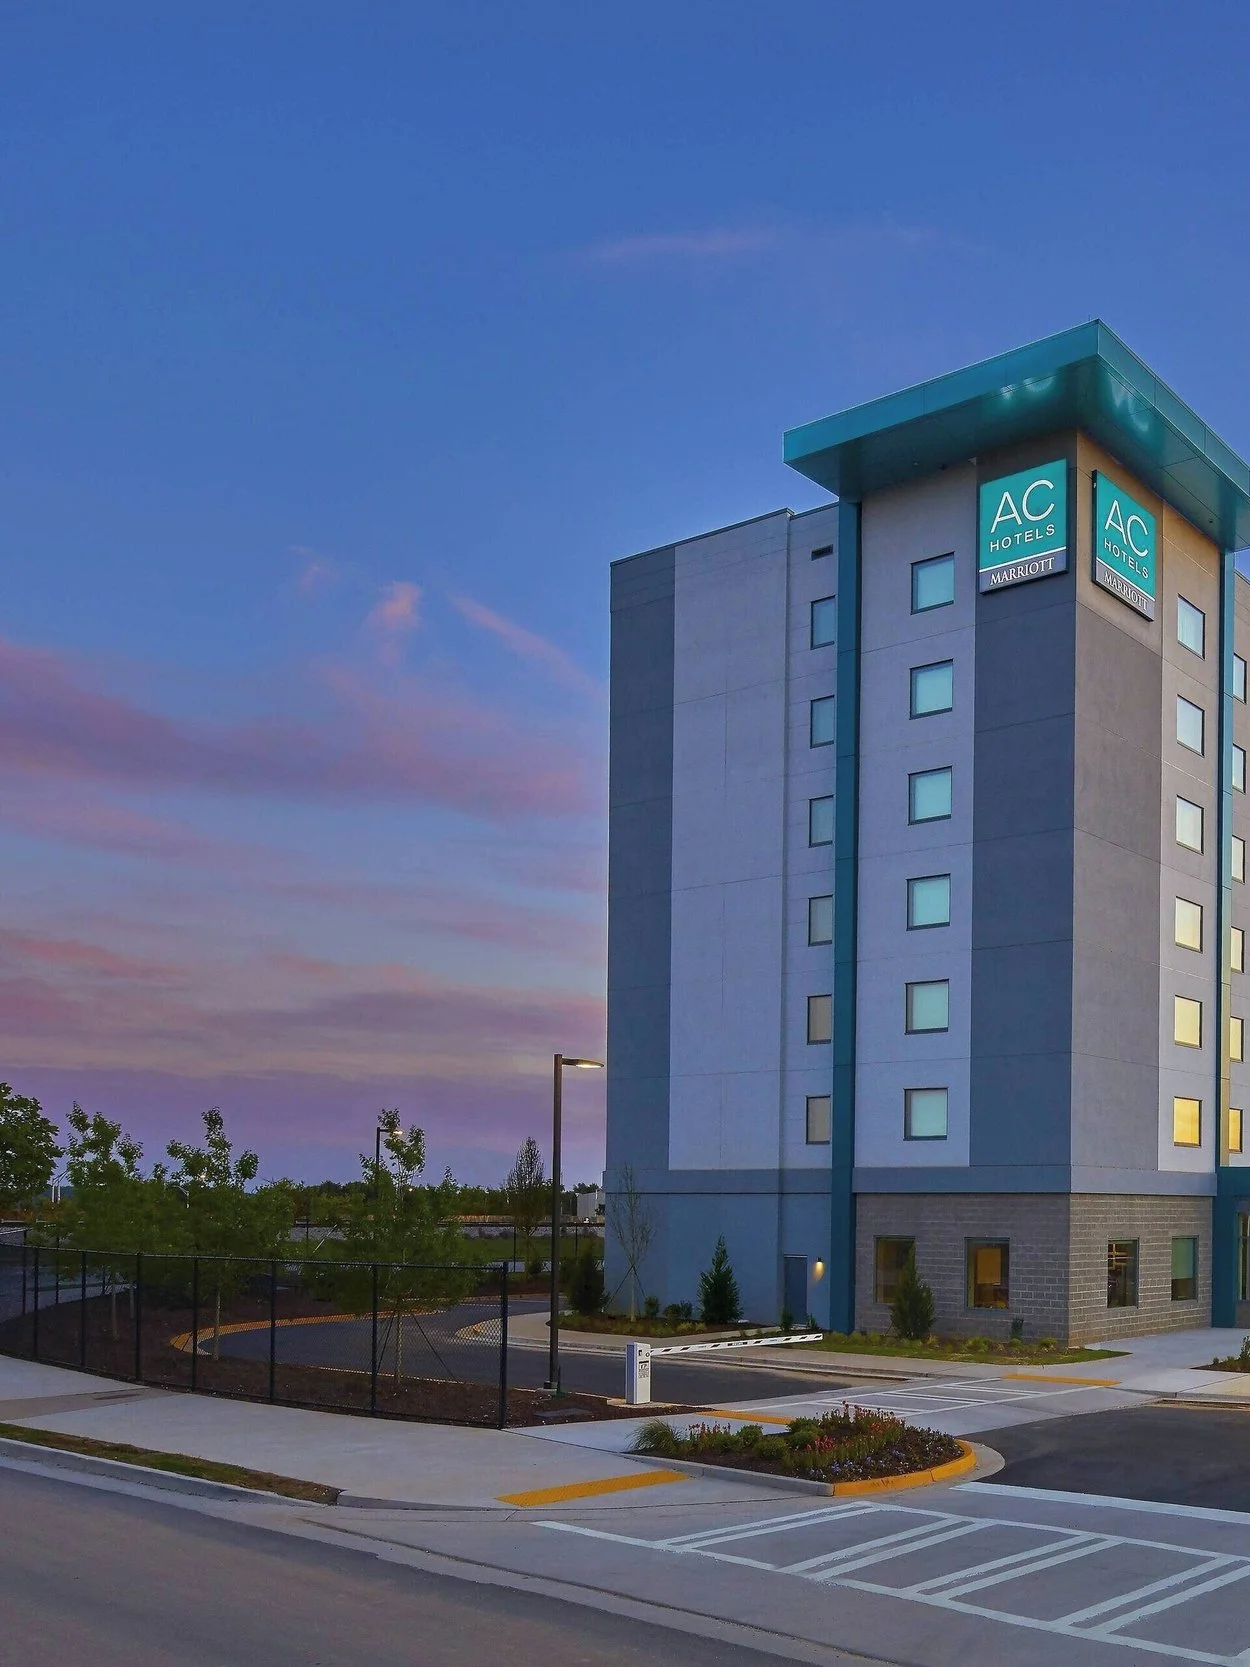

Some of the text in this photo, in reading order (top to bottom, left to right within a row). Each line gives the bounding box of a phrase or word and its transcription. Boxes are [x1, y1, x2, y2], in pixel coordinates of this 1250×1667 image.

[990, 479, 1055, 534] AC
[990, 523, 1055, 553] HOTELS
[1104, 499, 1148, 557] AC
[989, 557, 1055, 586] MARRIOTT
[1104, 537, 1149, 579] HOTELS
[1103, 570, 1148, 611] MARRIOTT
